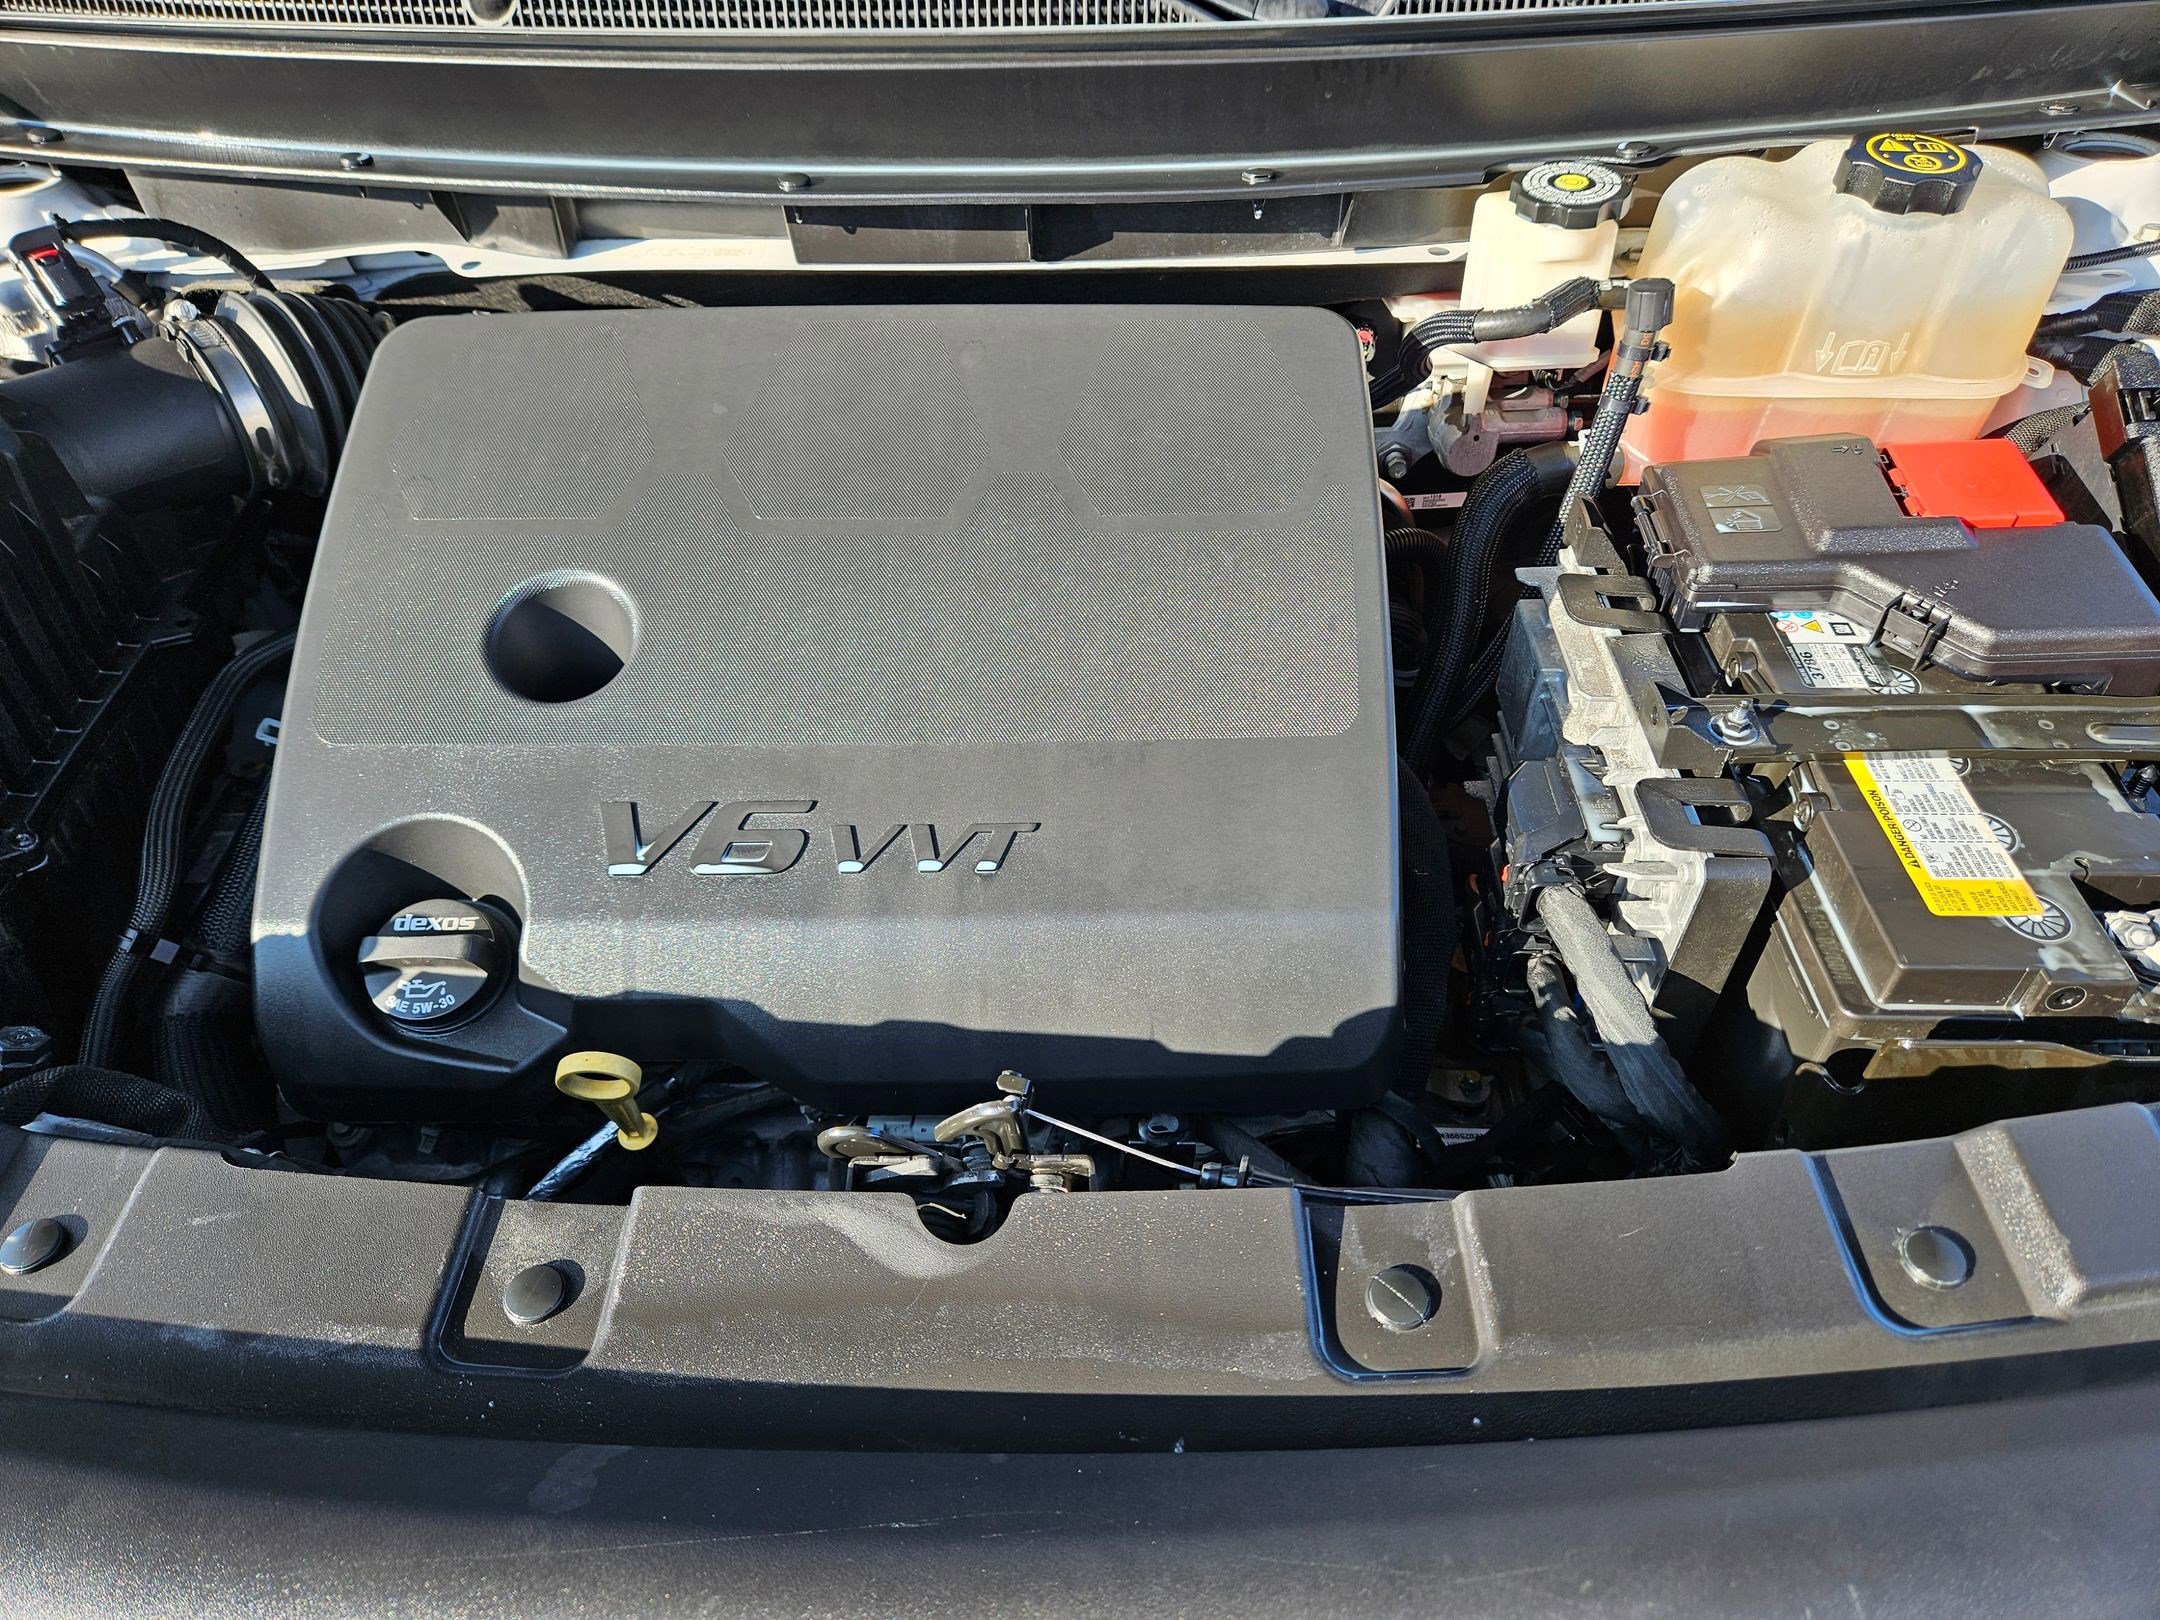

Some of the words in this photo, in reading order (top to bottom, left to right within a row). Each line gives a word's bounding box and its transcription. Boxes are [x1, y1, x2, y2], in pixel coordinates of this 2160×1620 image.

[1800, 651, 1825, 680] 3786
[601, 800, 819, 875] V6
[831, 823, 1041, 874] VVT
[1867, 789, 1915, 859] DANGER/POISON
[393, 913, 480, 931] dexos
[385, 995, 408, 1014] SAE
[411, 994, 456, 1015] 5W-30
